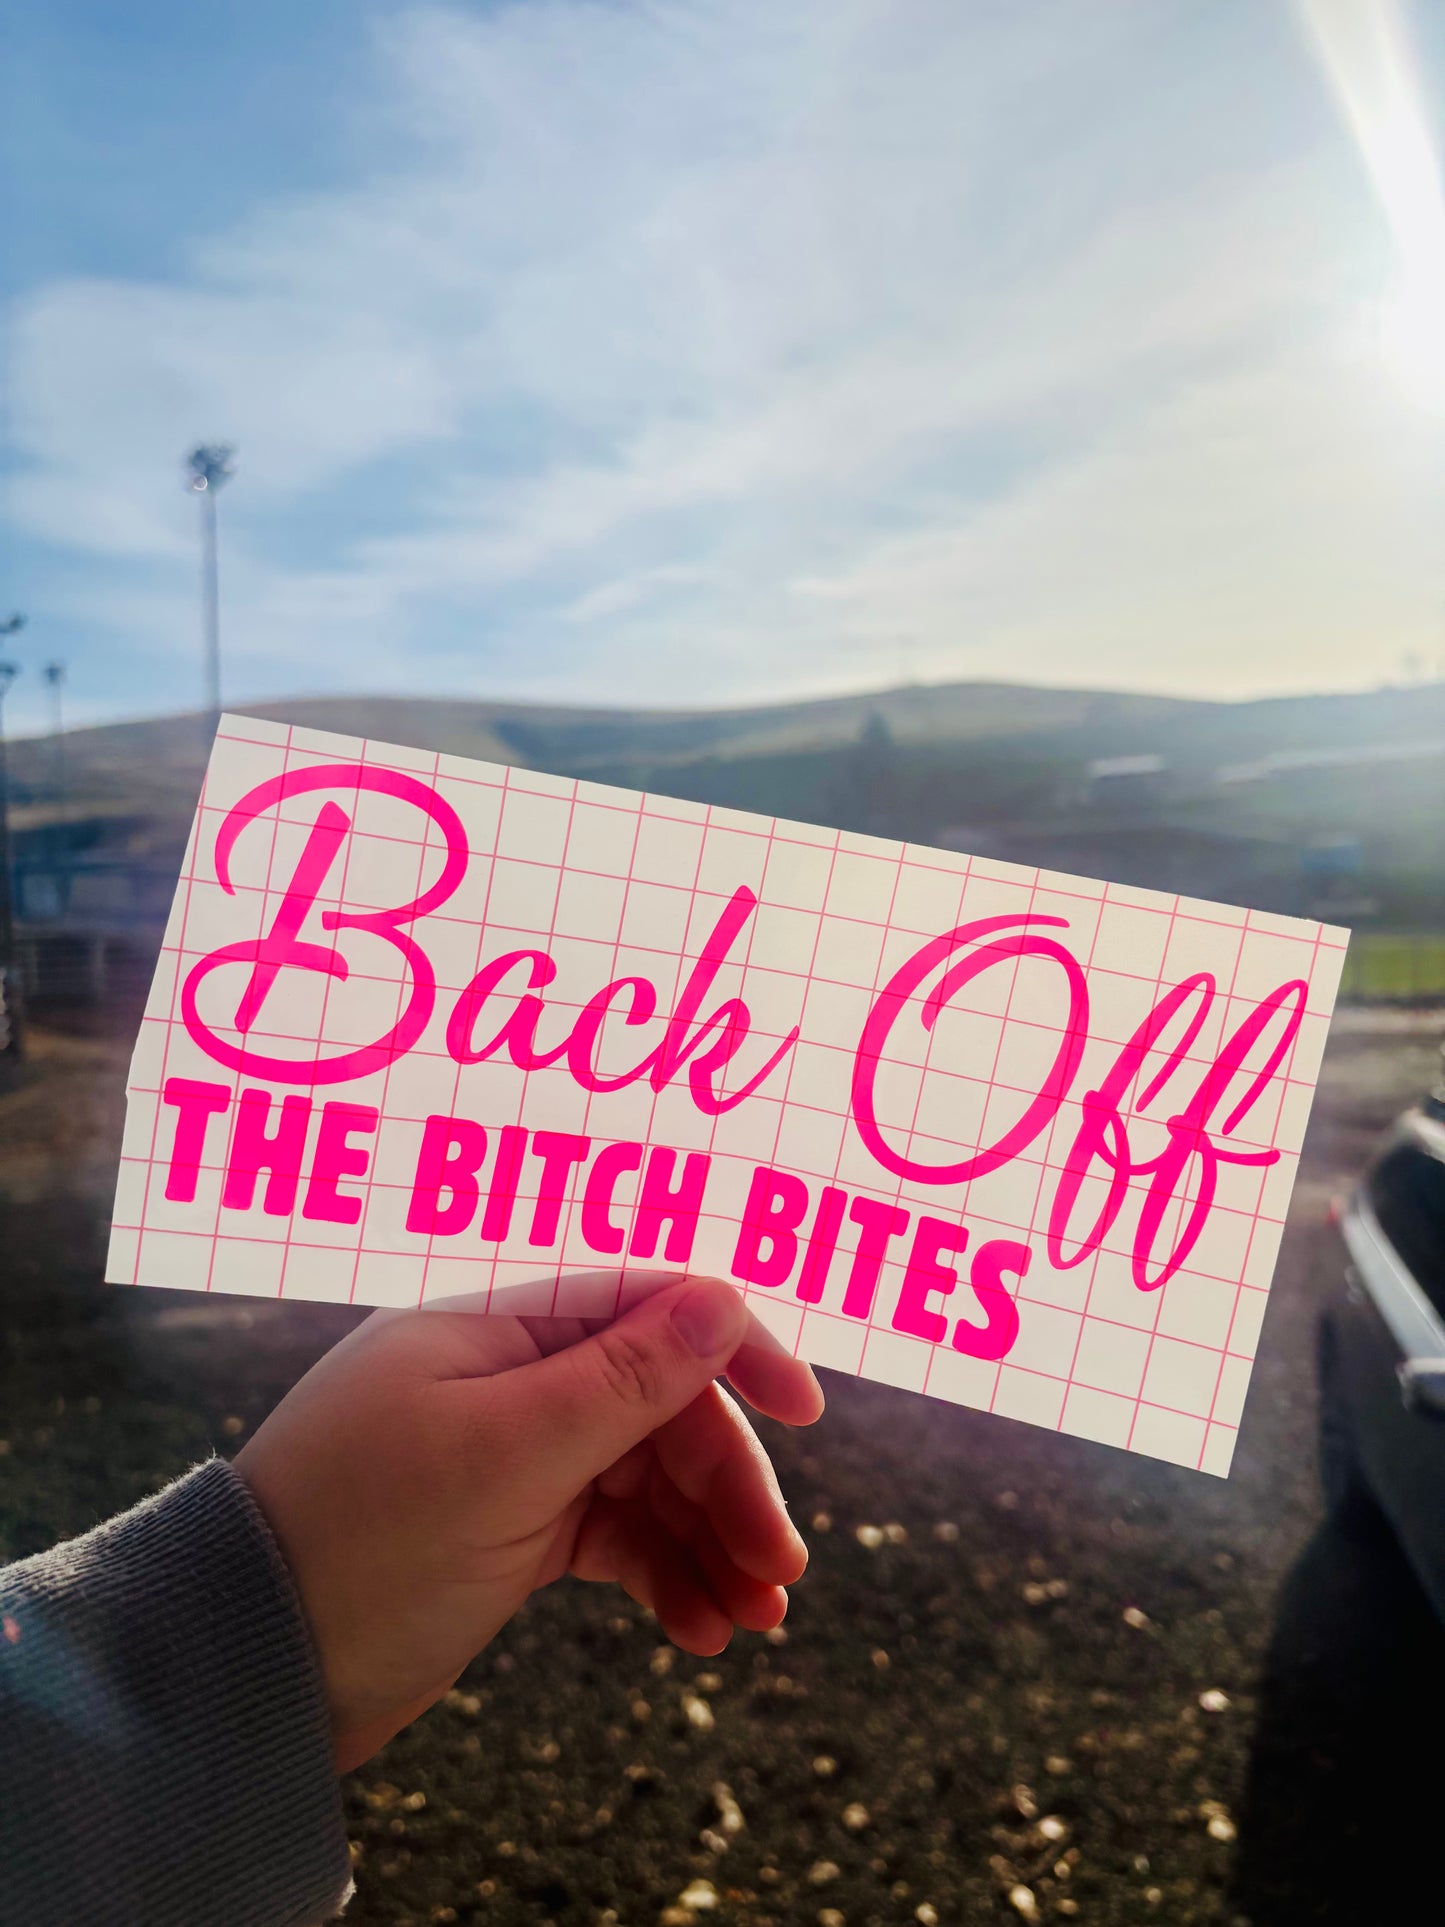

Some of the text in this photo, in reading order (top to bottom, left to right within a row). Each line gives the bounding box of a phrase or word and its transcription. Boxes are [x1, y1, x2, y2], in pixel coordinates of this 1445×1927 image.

[163, 1077, 1032, 1362] THE BITCH BITES
[181, 763, 1309, 1293] Back Off
